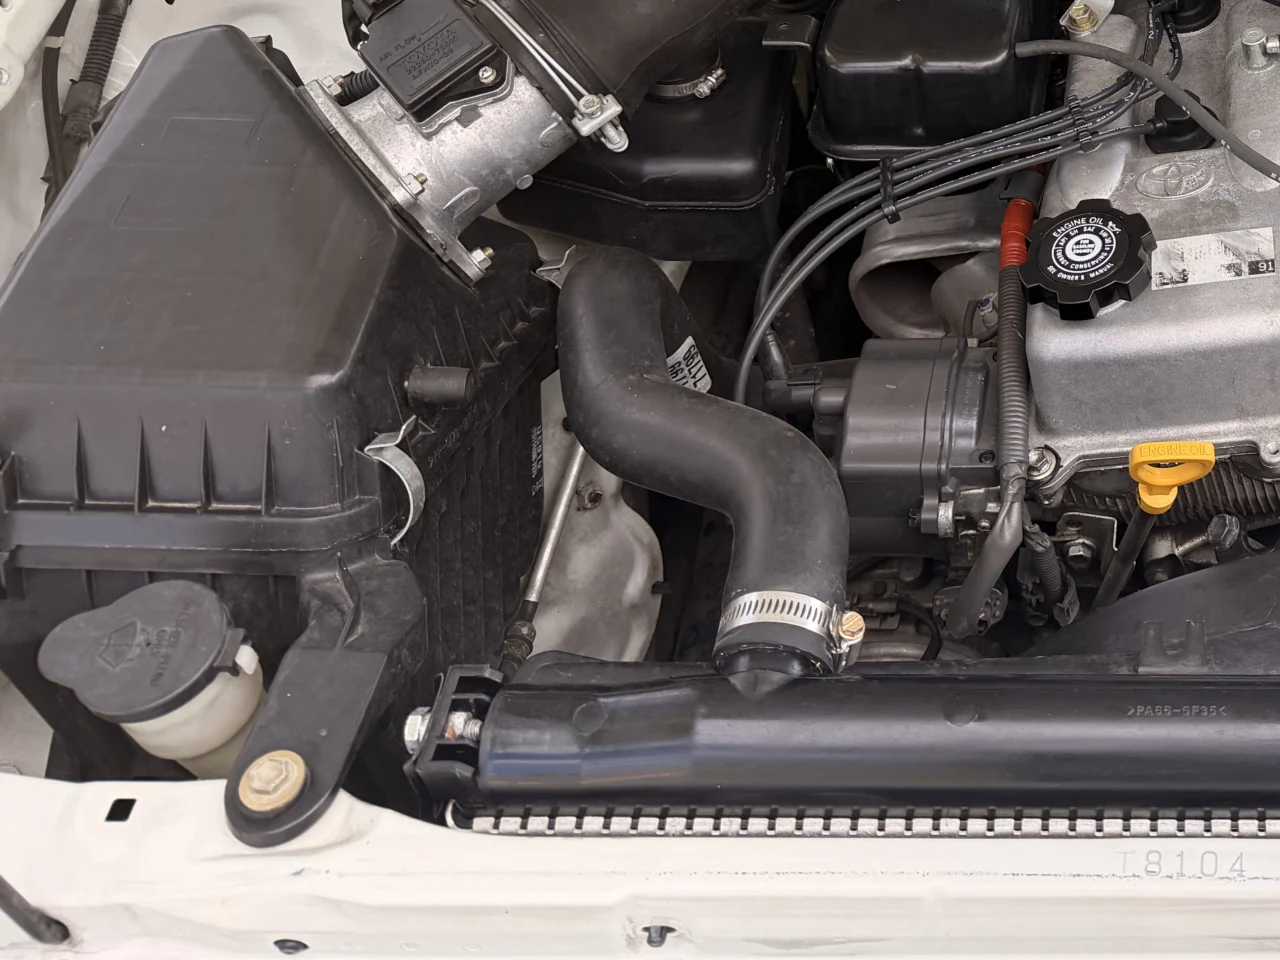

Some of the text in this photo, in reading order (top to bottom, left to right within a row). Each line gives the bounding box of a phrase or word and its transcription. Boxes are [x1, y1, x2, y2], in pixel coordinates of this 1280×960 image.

[393, 33, 418, 52] FLOW
[397, 29, 457, 68] TOYOTA
[1052, 217, 1103, 237] ENGINE OIL
[1056, 249, 1108, 269] ENERGY CONSERVING
[1258, 262, 1274, 271] 91
[1047, 265, 1057, 274] SEE
[1089, 262, 1114, 278] MANUAL
[1140, 443, 1211, 457] ENGINE OIL
